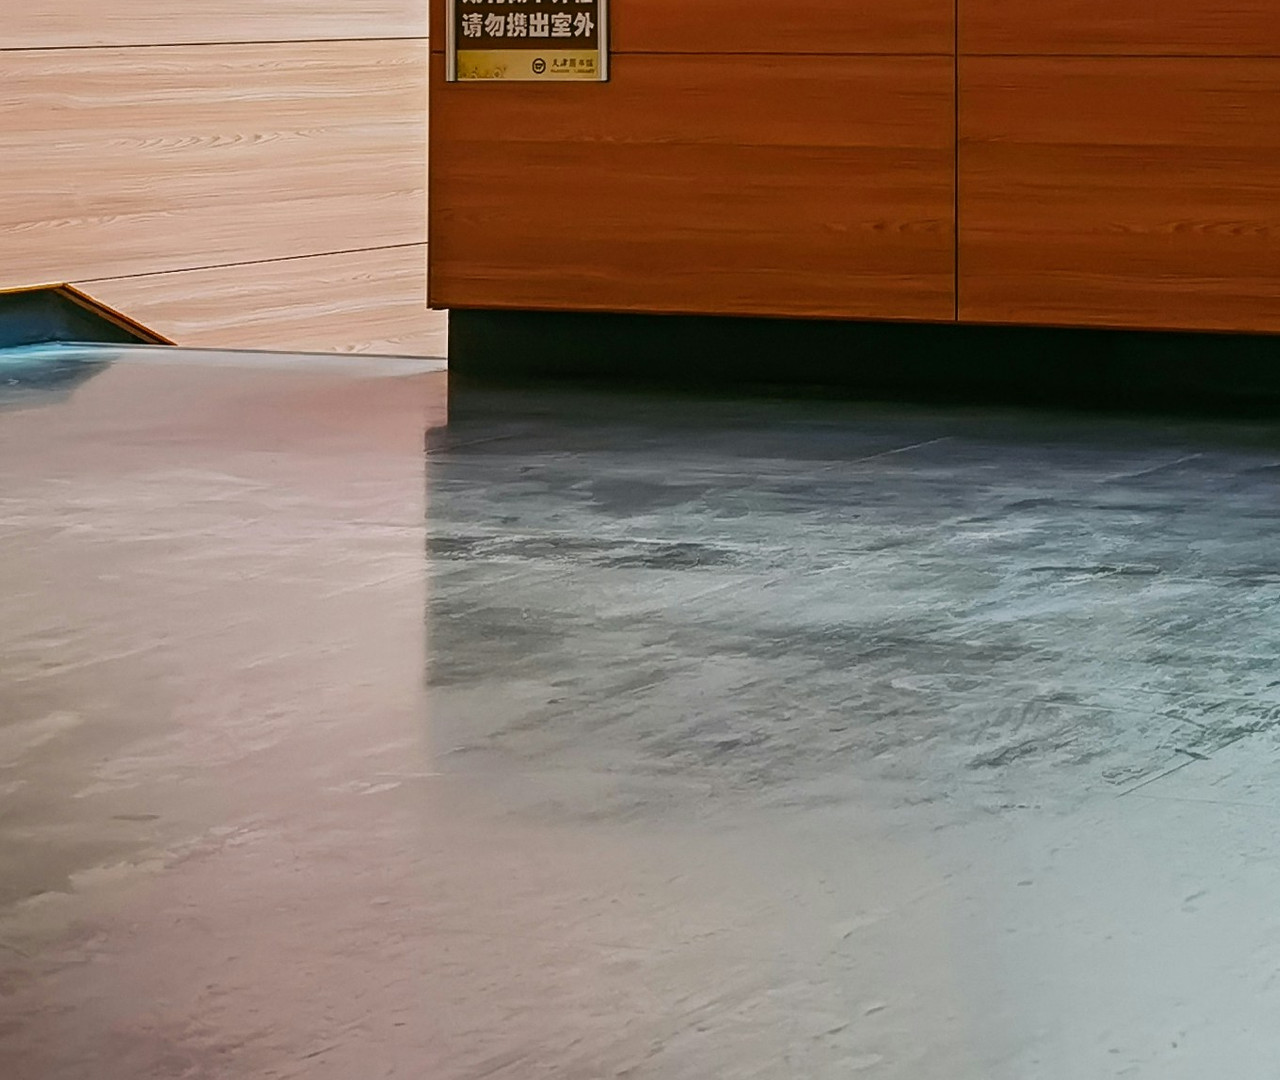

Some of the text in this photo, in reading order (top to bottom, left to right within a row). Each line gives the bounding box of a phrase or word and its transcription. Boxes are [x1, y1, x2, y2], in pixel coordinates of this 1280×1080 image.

[461, 12, 594, 38] 请勿携出室外
